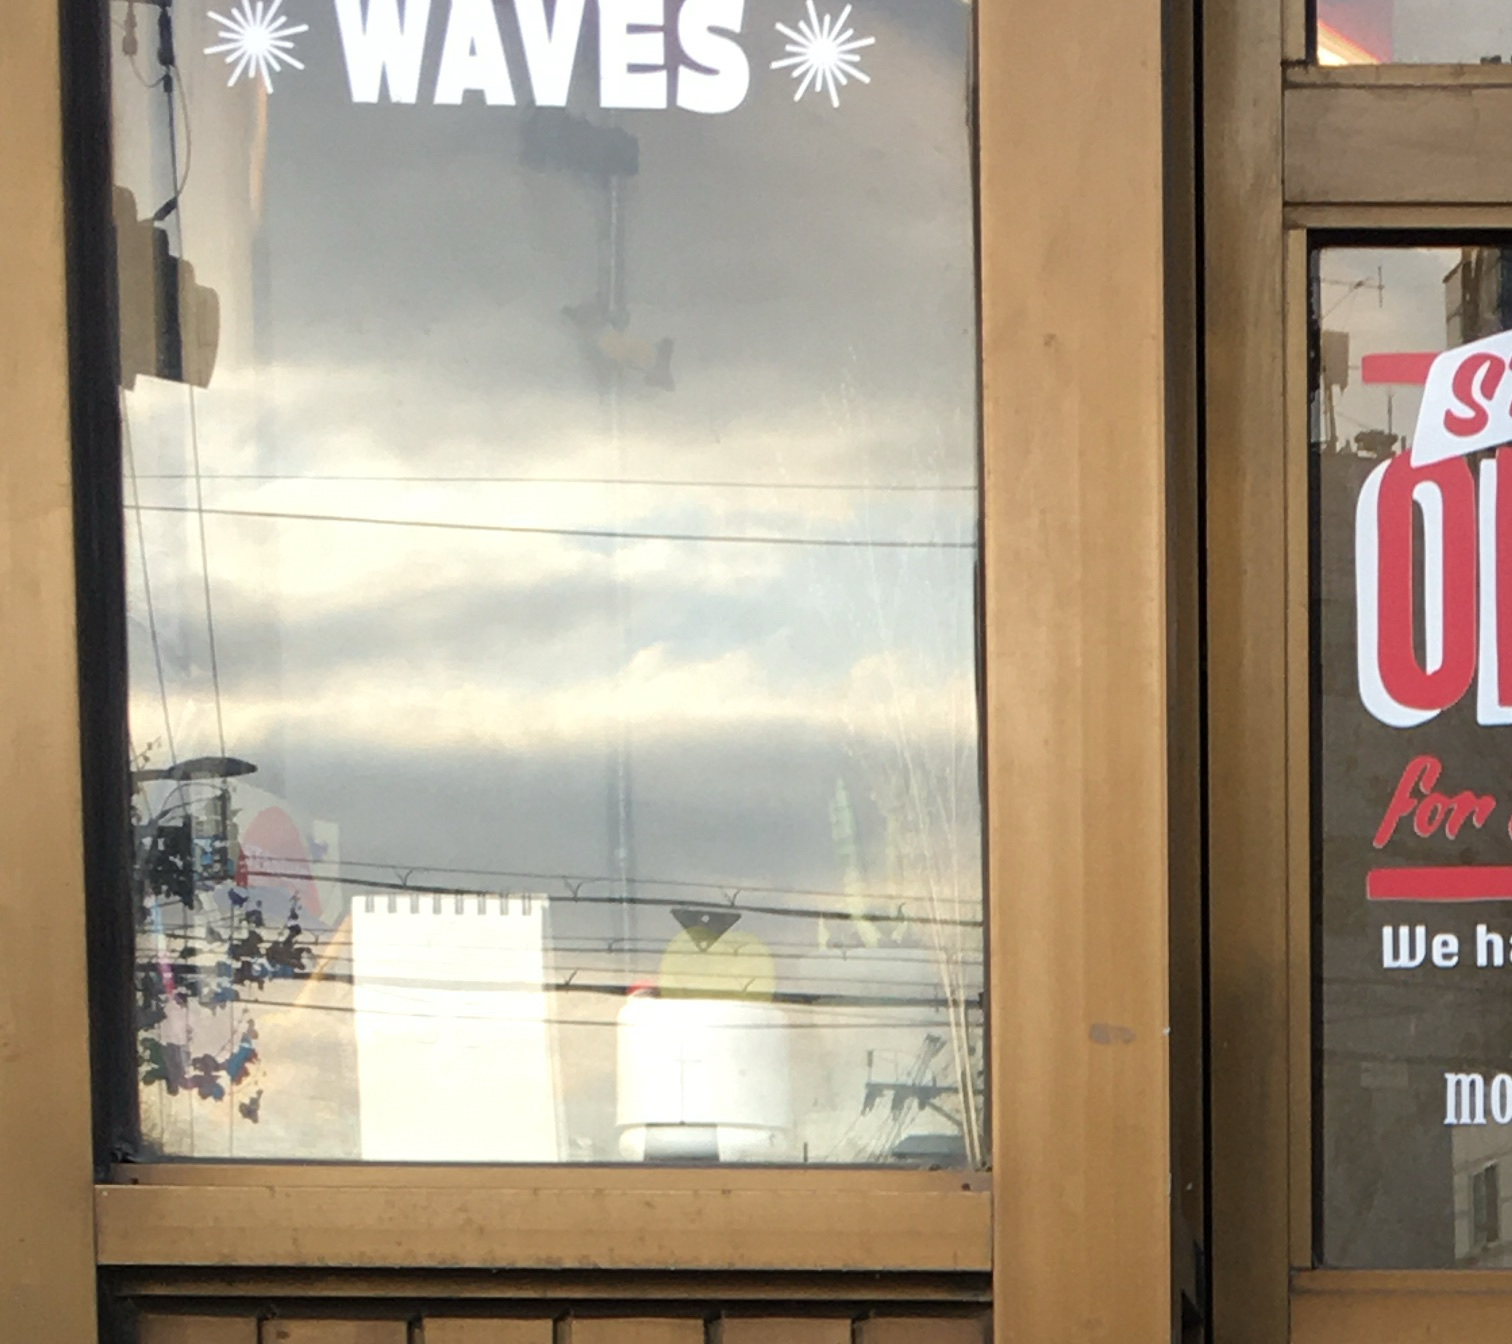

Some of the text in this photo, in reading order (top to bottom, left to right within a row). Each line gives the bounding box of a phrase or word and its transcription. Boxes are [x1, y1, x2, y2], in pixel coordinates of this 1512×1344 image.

[334, 0, 750, 114] WAVES
[1372, 755, 1496, 848] for
[1381, 925, 1459, 969] We
